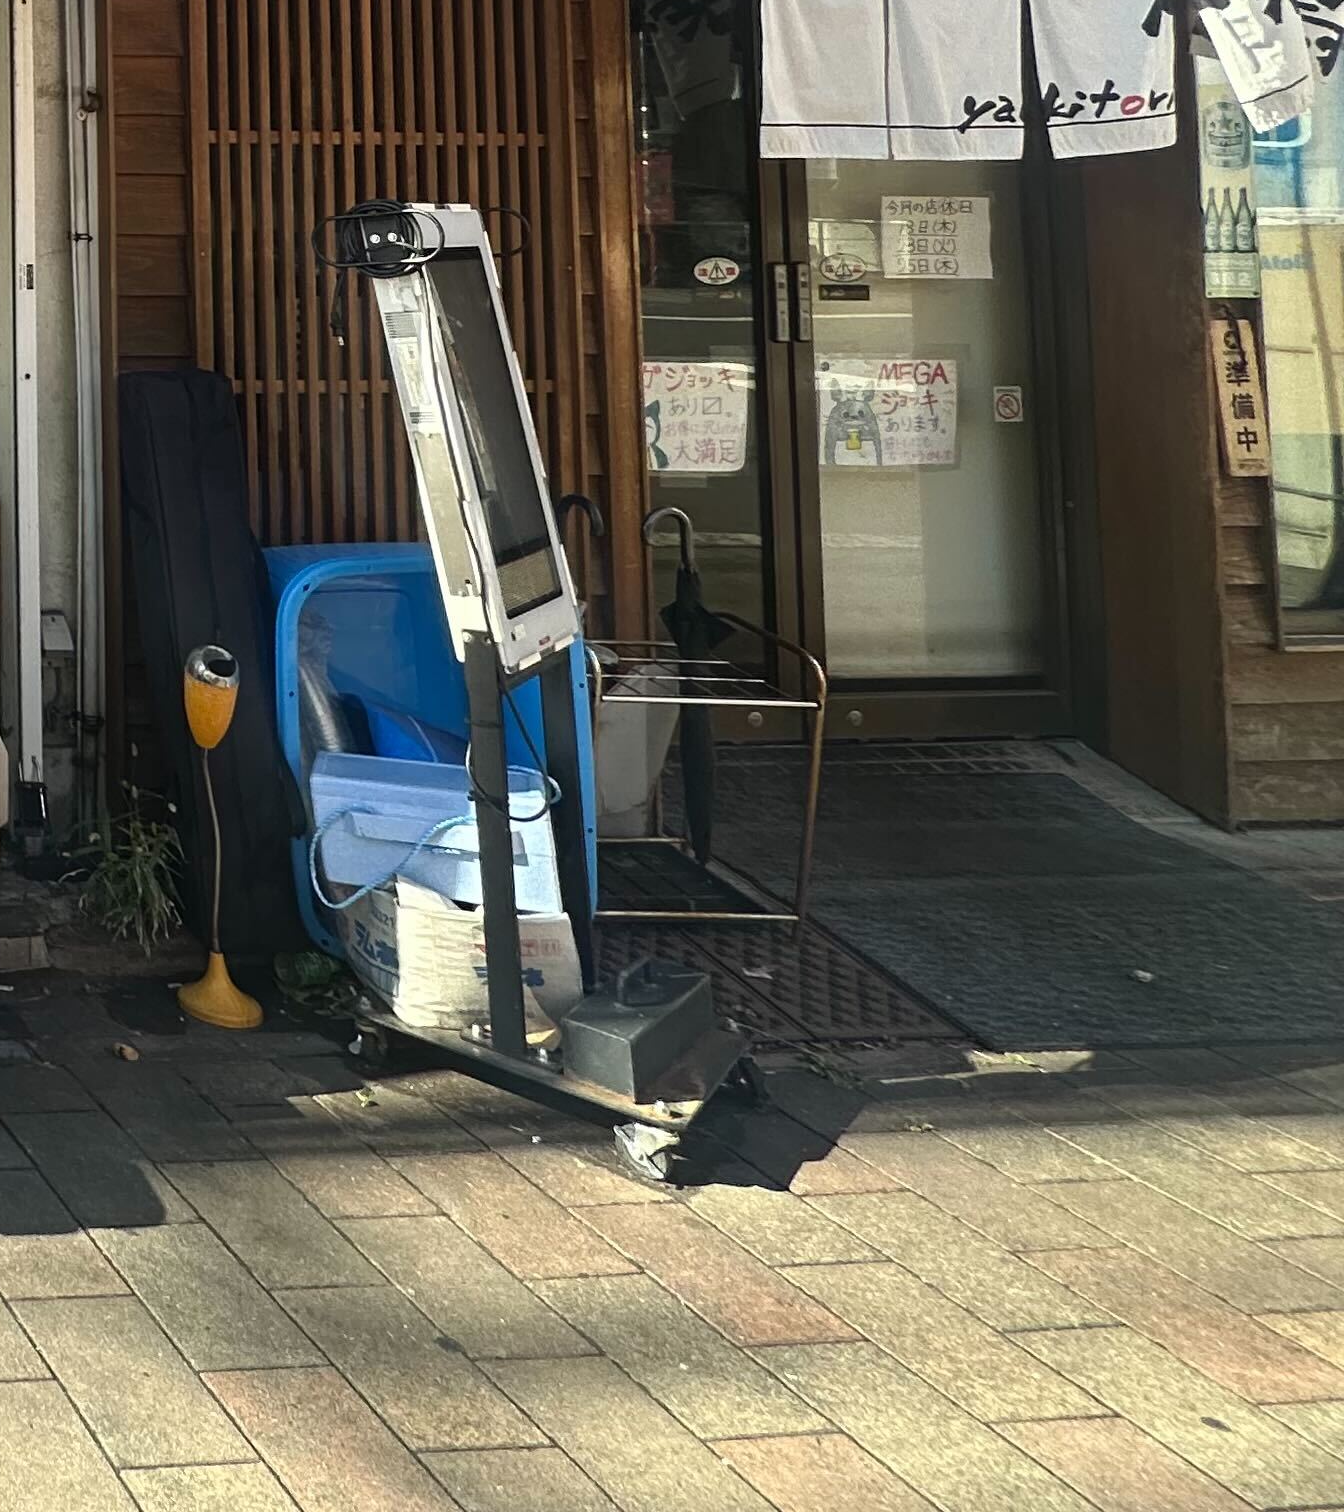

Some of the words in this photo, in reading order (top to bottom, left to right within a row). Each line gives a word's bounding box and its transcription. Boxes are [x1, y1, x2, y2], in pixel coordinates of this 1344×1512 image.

[885, 199, 973, 215] 今月の店休日
[878, 389, 939, 416] ジョッキ
